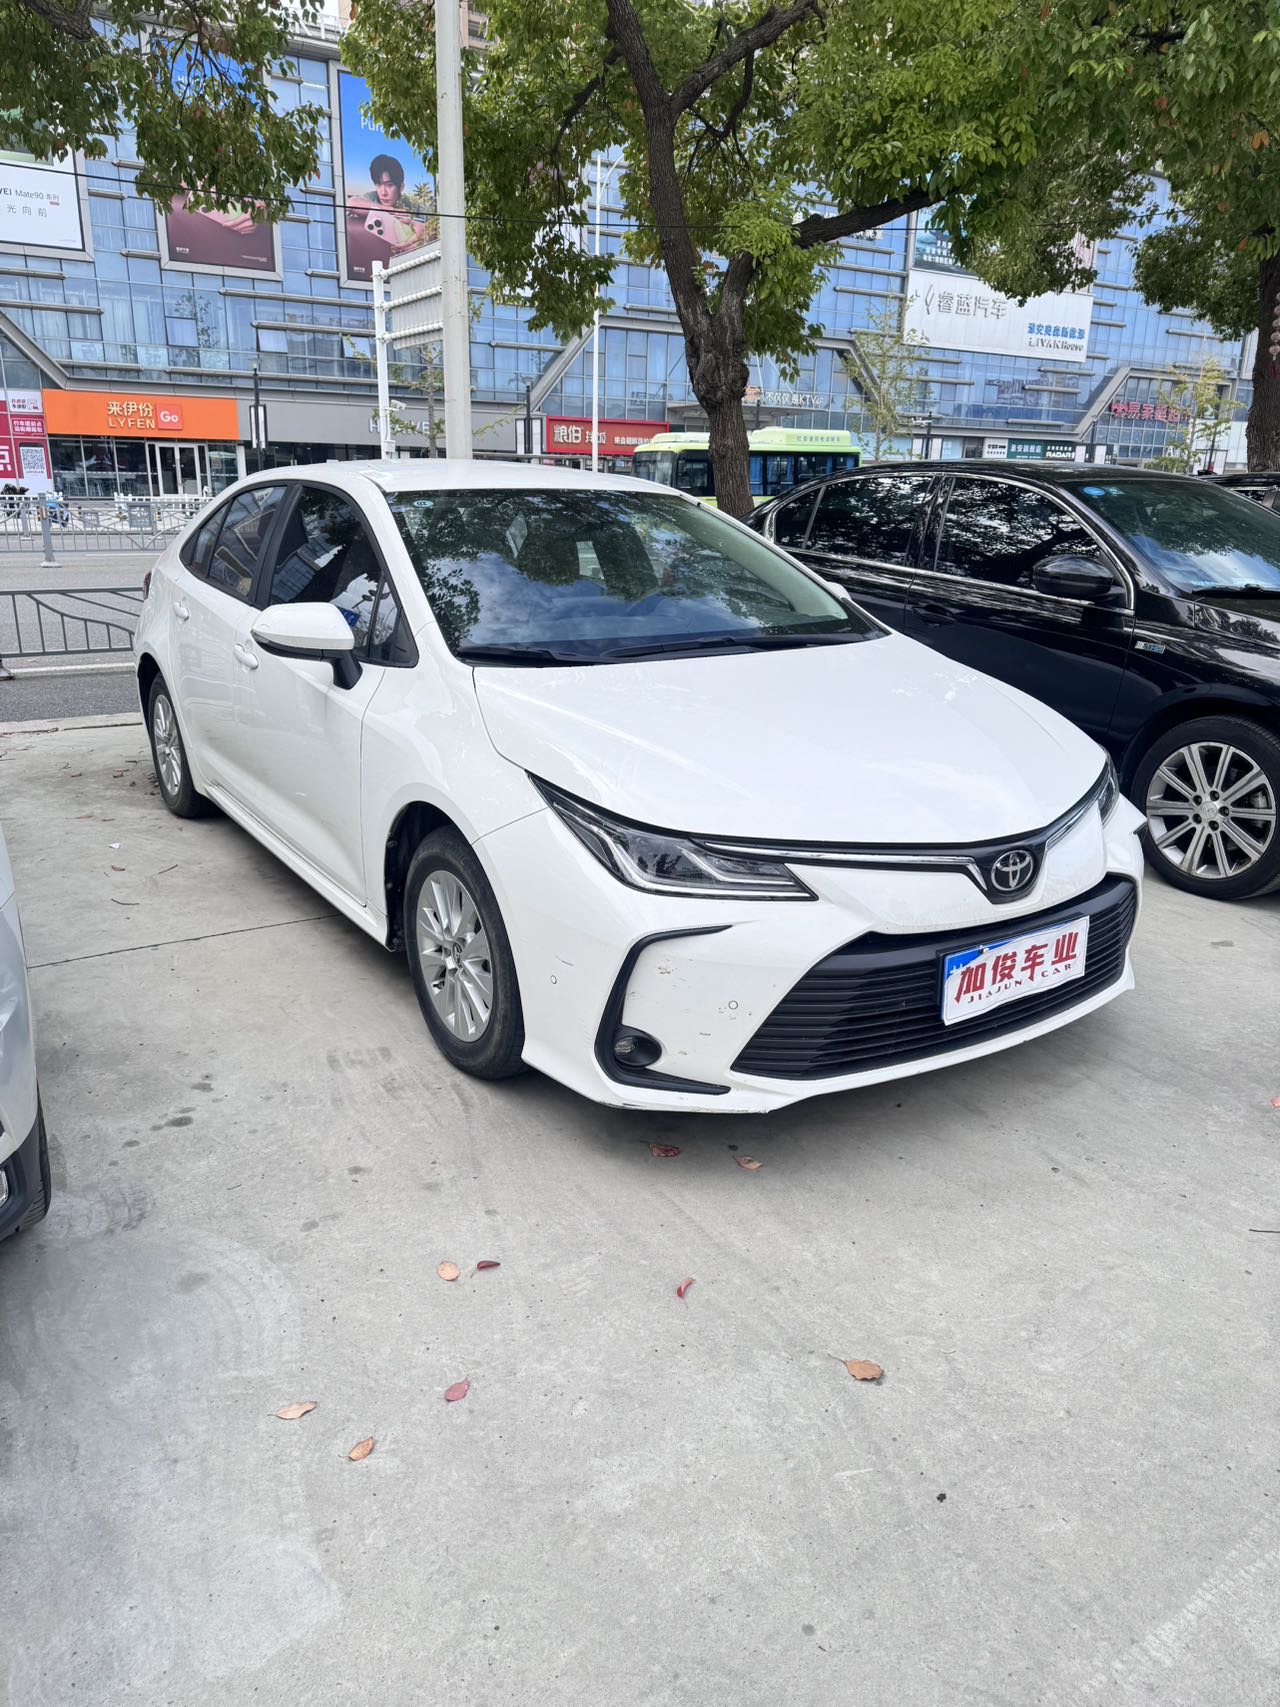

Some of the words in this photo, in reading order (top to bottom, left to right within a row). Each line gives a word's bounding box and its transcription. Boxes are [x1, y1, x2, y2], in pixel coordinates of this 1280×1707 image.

[938, 291, 1008, 319] 睿蓝汽车
[107, 401, 153, 417] 来伊份
[160, 410, 179, 423] Go
[108, 417, 155, 429] LYFEN
[554, 425, 582, 444] 粮伯
[954, 931, 1079, 1004] 加俊车业
[967, 978, 1023, 1004] JIAJUN
[1040, 963, 1072, 978] CAR
